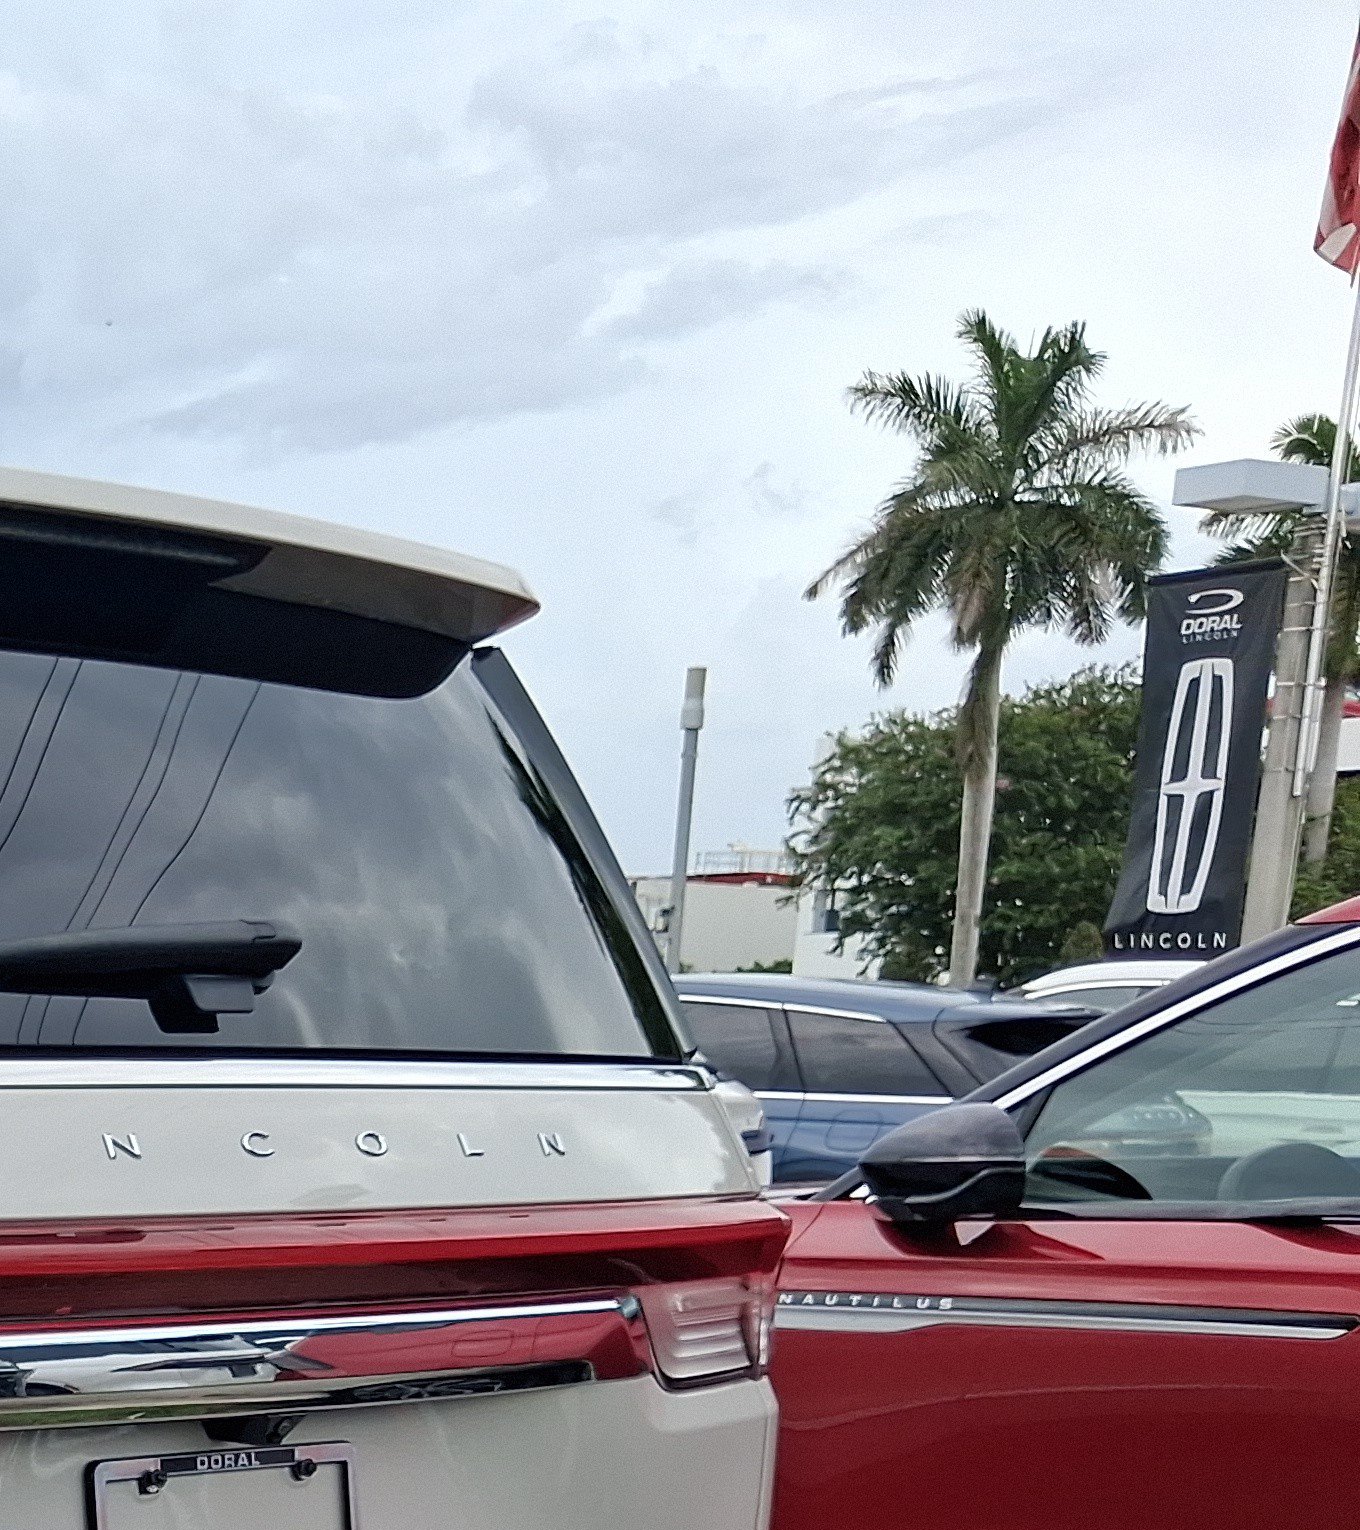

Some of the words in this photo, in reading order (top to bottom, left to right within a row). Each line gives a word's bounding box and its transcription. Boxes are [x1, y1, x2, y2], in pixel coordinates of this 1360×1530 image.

[1181, 613, 1243, 635] DORAL
[1182, 630, 1238, 644] LINCOLN
[1113, 932, 1227, 949] LINCOLN
[779, 1293, 953, 1310] NAUTILUS
[196, 1452, 260, 1471] DORAL
